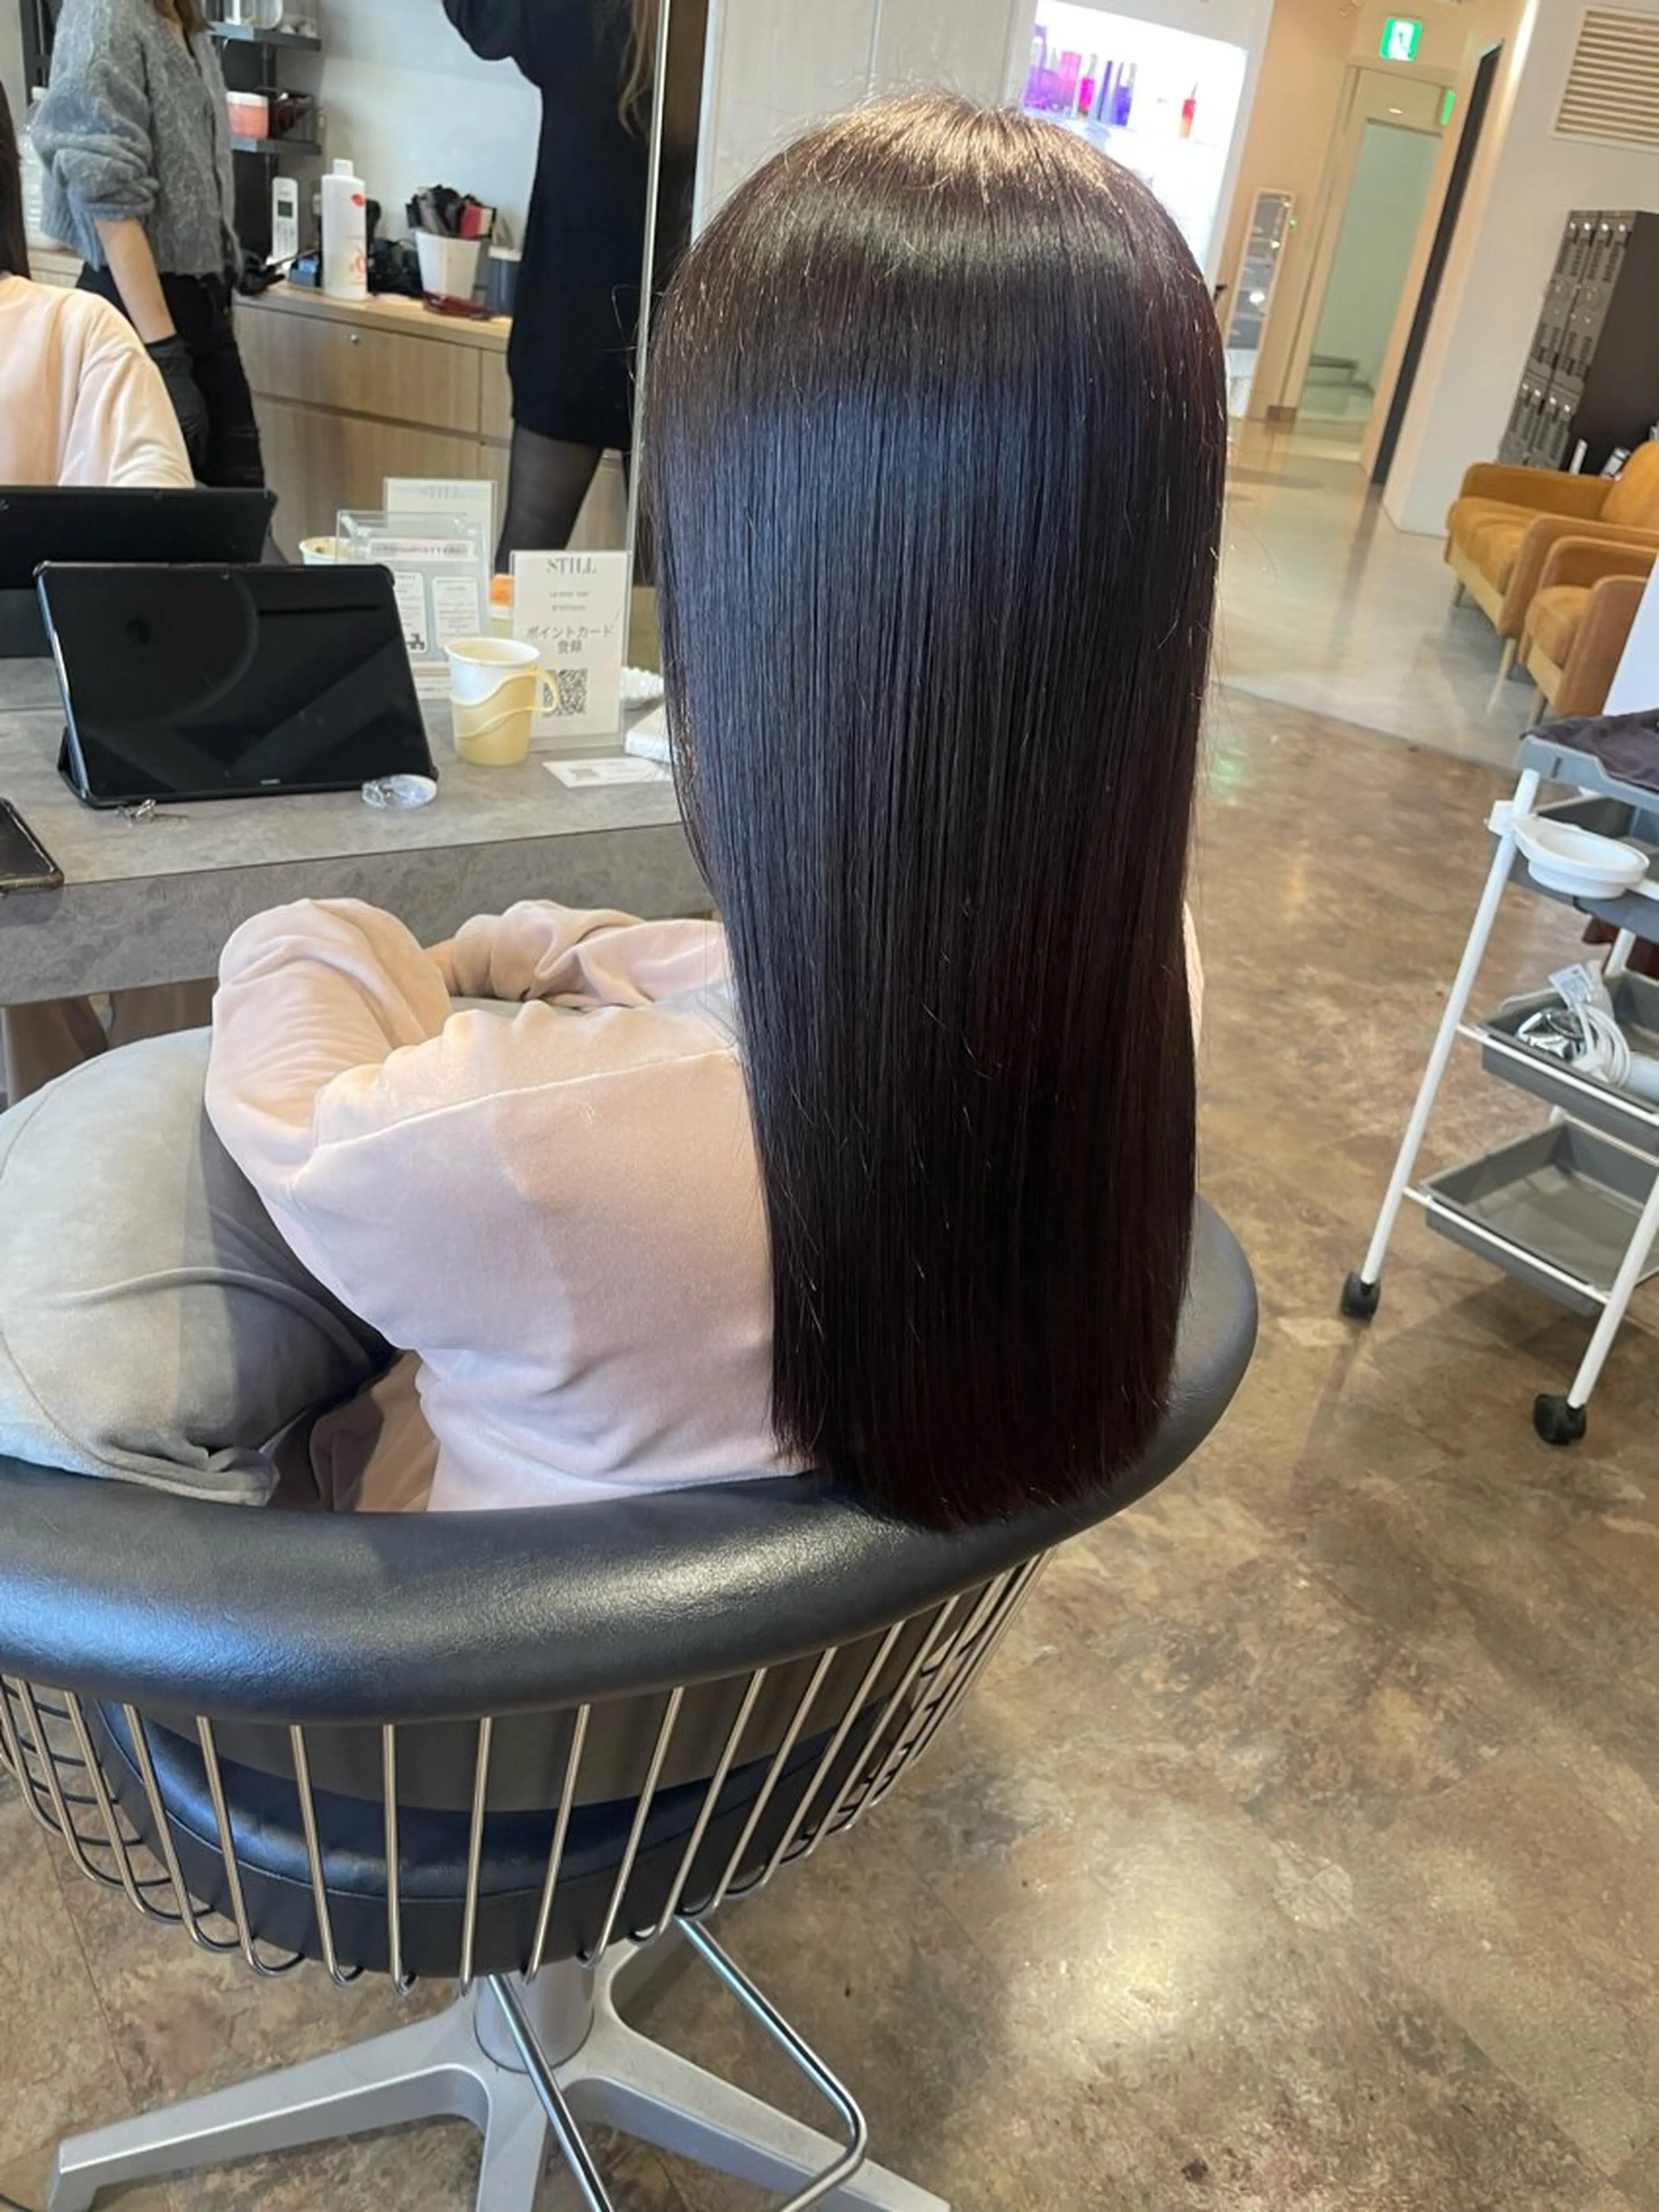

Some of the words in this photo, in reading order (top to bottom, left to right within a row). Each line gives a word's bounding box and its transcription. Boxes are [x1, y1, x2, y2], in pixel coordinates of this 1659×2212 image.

[546, 556, 597, 574] STILL
[526, 623, 615, 639] ポイントカード
